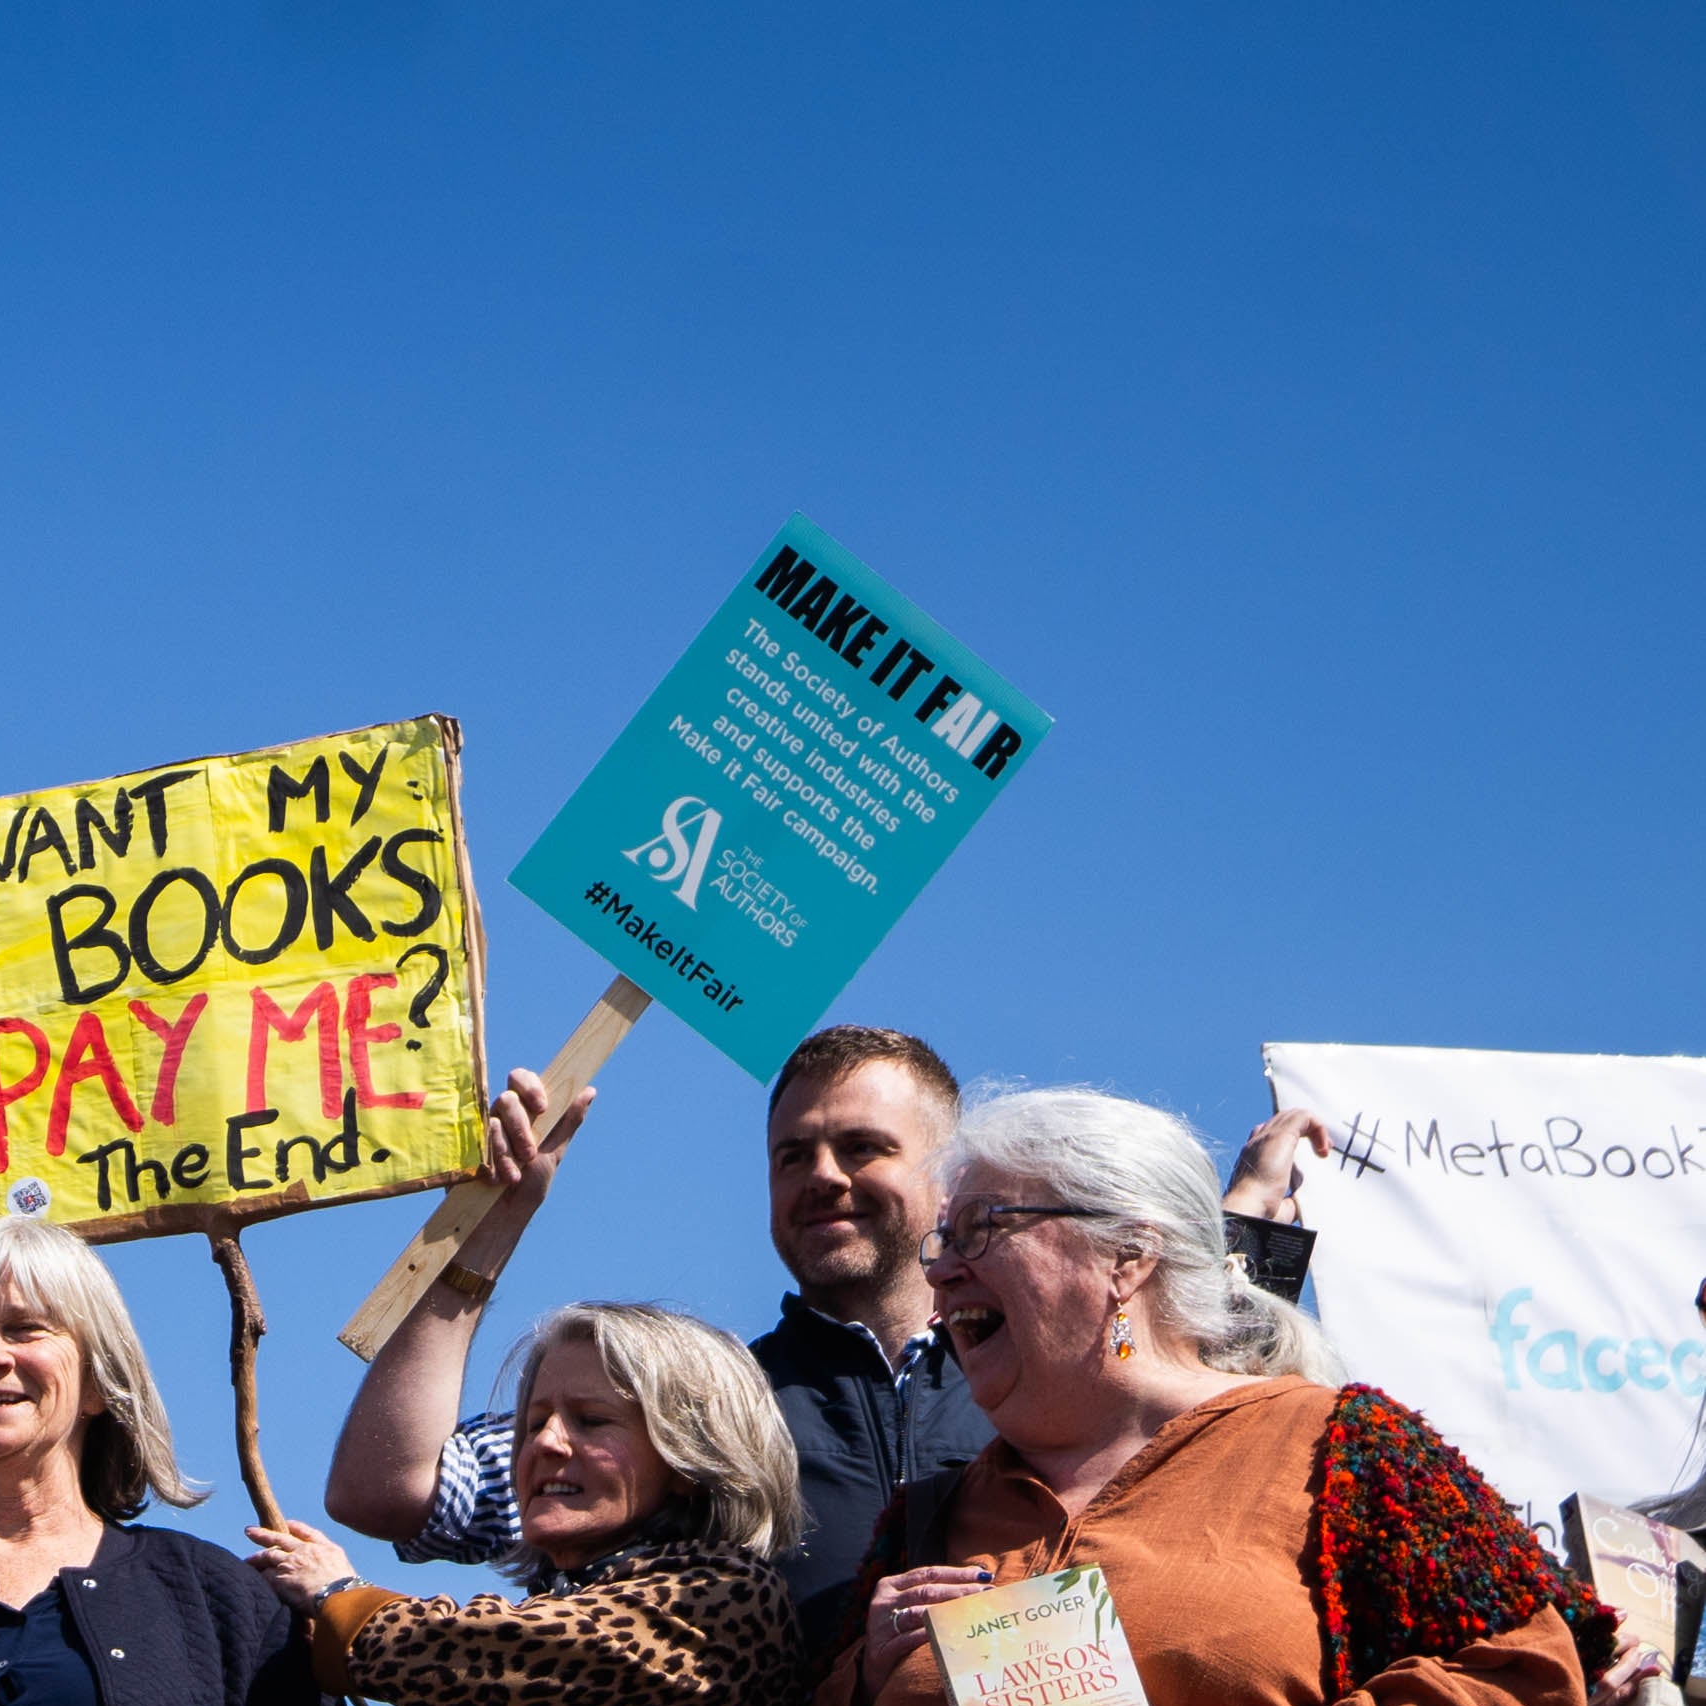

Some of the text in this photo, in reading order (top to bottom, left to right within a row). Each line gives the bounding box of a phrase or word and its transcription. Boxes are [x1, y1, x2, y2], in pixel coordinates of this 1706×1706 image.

[743, 618, 960, 804] The Society of Authors
[754, 543, 1023, 782] MAKE IT FAIR
[267, 745, 388, 834] MY
[712, 715, 877, 851] and supports the
[725, 648, 937, 824] stands united with the
[725, 687, 902, 833] creative industries
[668, 713, 879, 896] Make it Fair campaign.
[740, 845, 765, 870] THE
[709, 874, 798, 948] AUTHORS
[716, 849, 809, 930] SOCIETY OF
[584, 880, 745, 1013] #MakeItFair
[76, 1086, 391, 1212] The End.
[1333, 1110, 1706, 1180] #MetaBook
[966, 1595, 1086, 1640] JANET GOVER
[973, 1639, 1113, 1698] LAWSON
[1024, 1640, 1050, 1658] The
